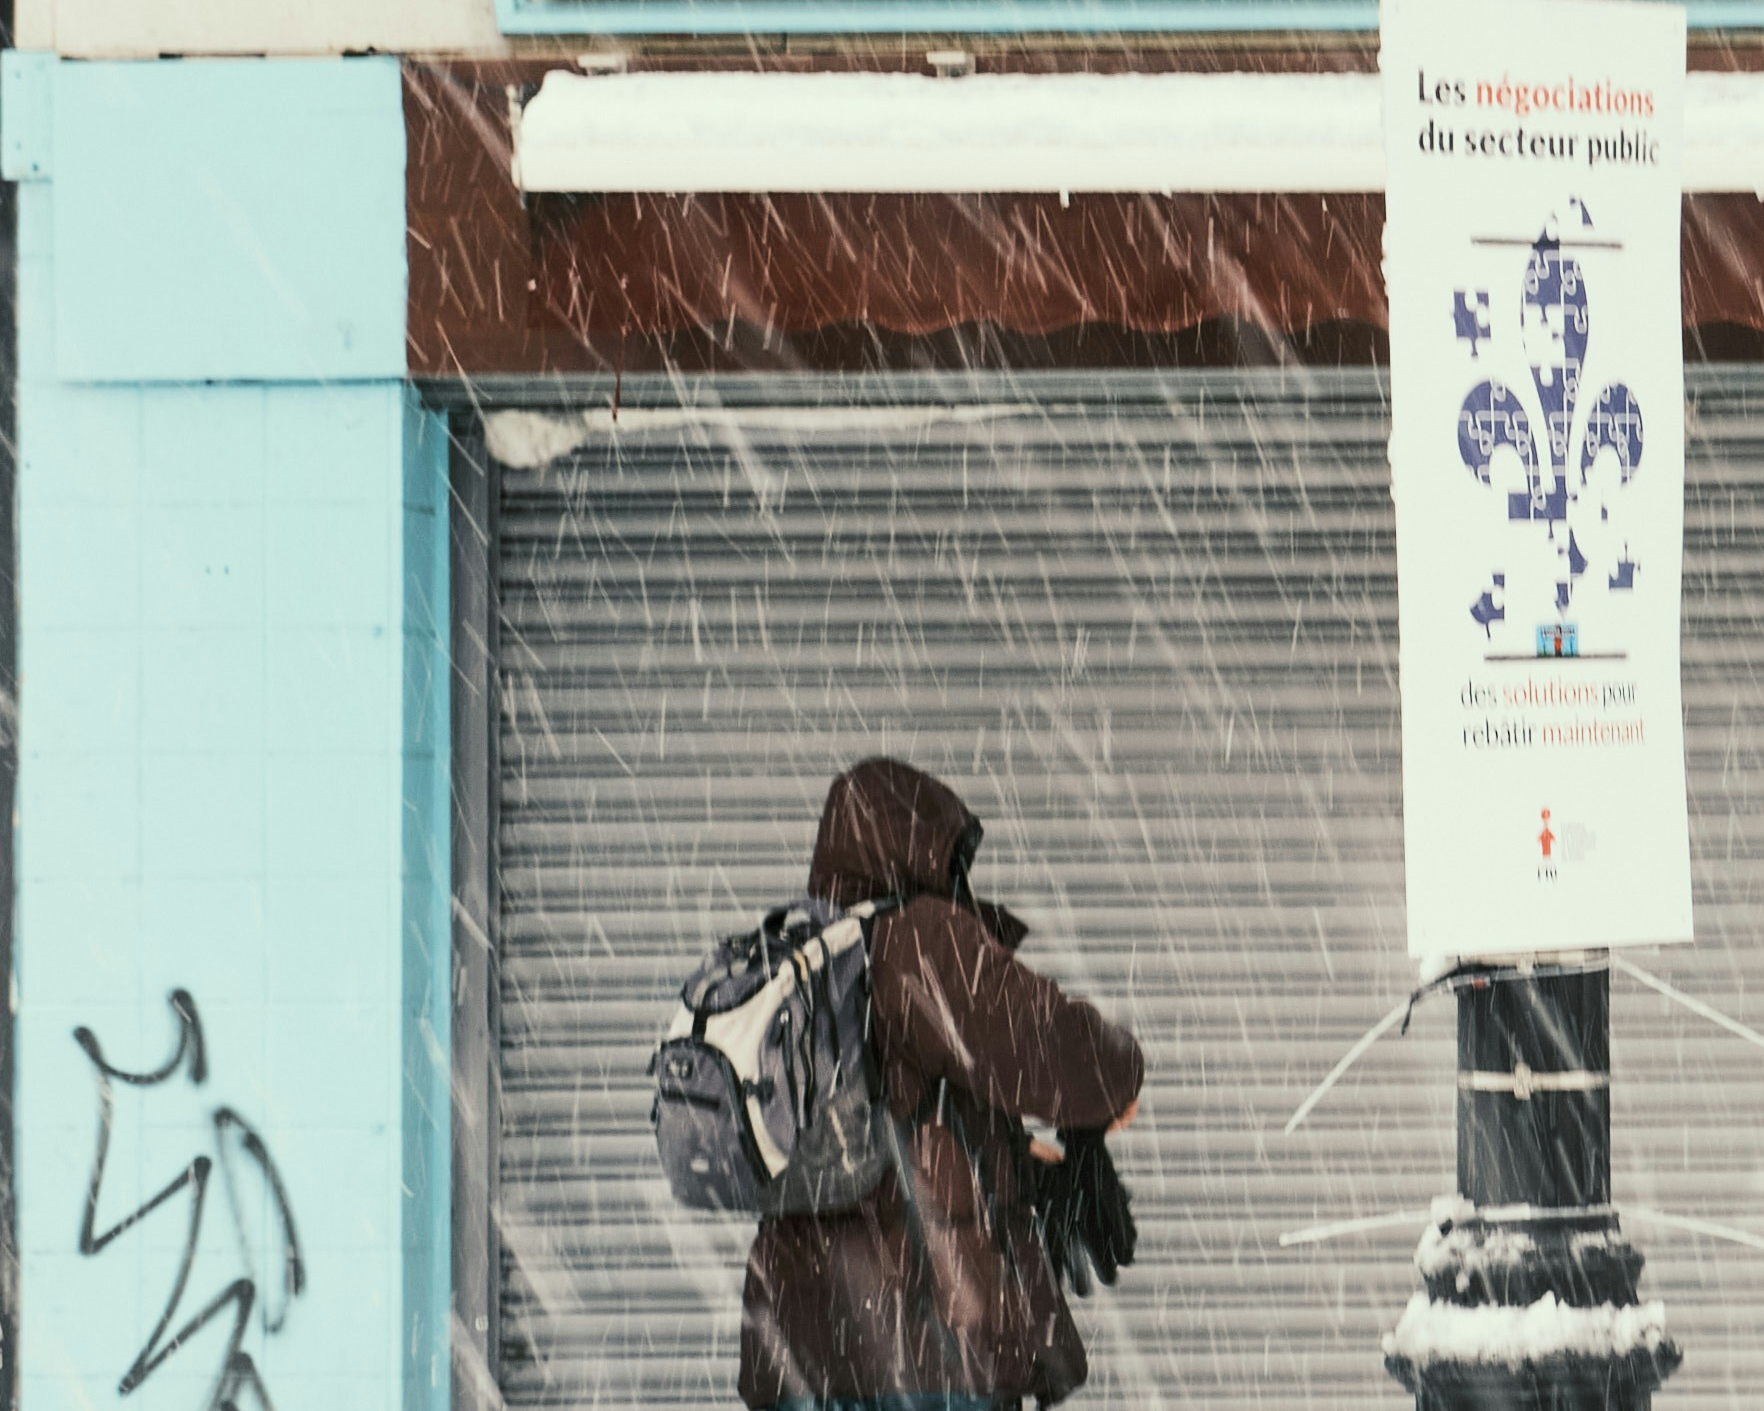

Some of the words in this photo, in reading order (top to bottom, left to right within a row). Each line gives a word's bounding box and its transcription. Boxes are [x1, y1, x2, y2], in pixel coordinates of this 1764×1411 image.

[1418, 64, 1466, 106] Les
[1476, 73, 1655, 117] négociations
[1418, 119, 1454, 153] du
[1464, 127, 1577, 160] secteur
[1588, 127, 1660, 169] public
[1460, 677, 1498, 708] des
[1503, 675, 1599, 708] solutions
[1602, 680, 1637, 712] pour
[1462, 715, 1536, 749] rebâtir
[1542, 714, 1646, 749] maintenant
